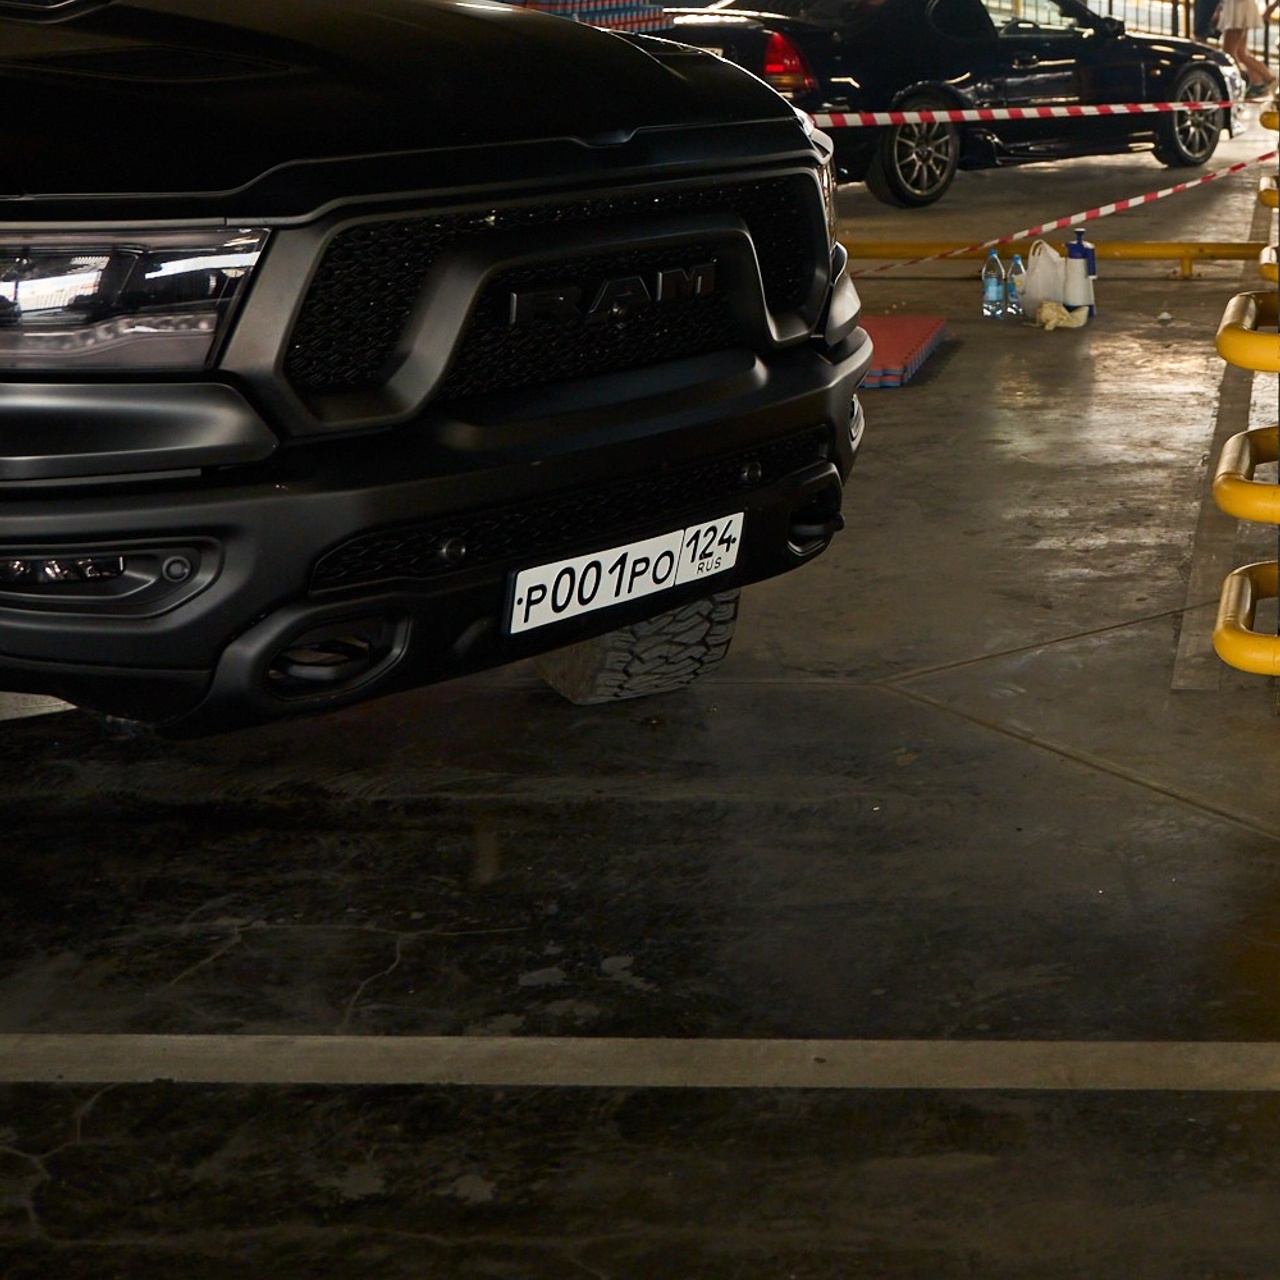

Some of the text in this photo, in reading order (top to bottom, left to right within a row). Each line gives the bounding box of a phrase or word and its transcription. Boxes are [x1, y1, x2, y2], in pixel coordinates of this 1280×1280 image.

[509, 263, 717, 326] RAM
[686, 519, 733, 564] 124
[696, 556, 722, 575] RUS
